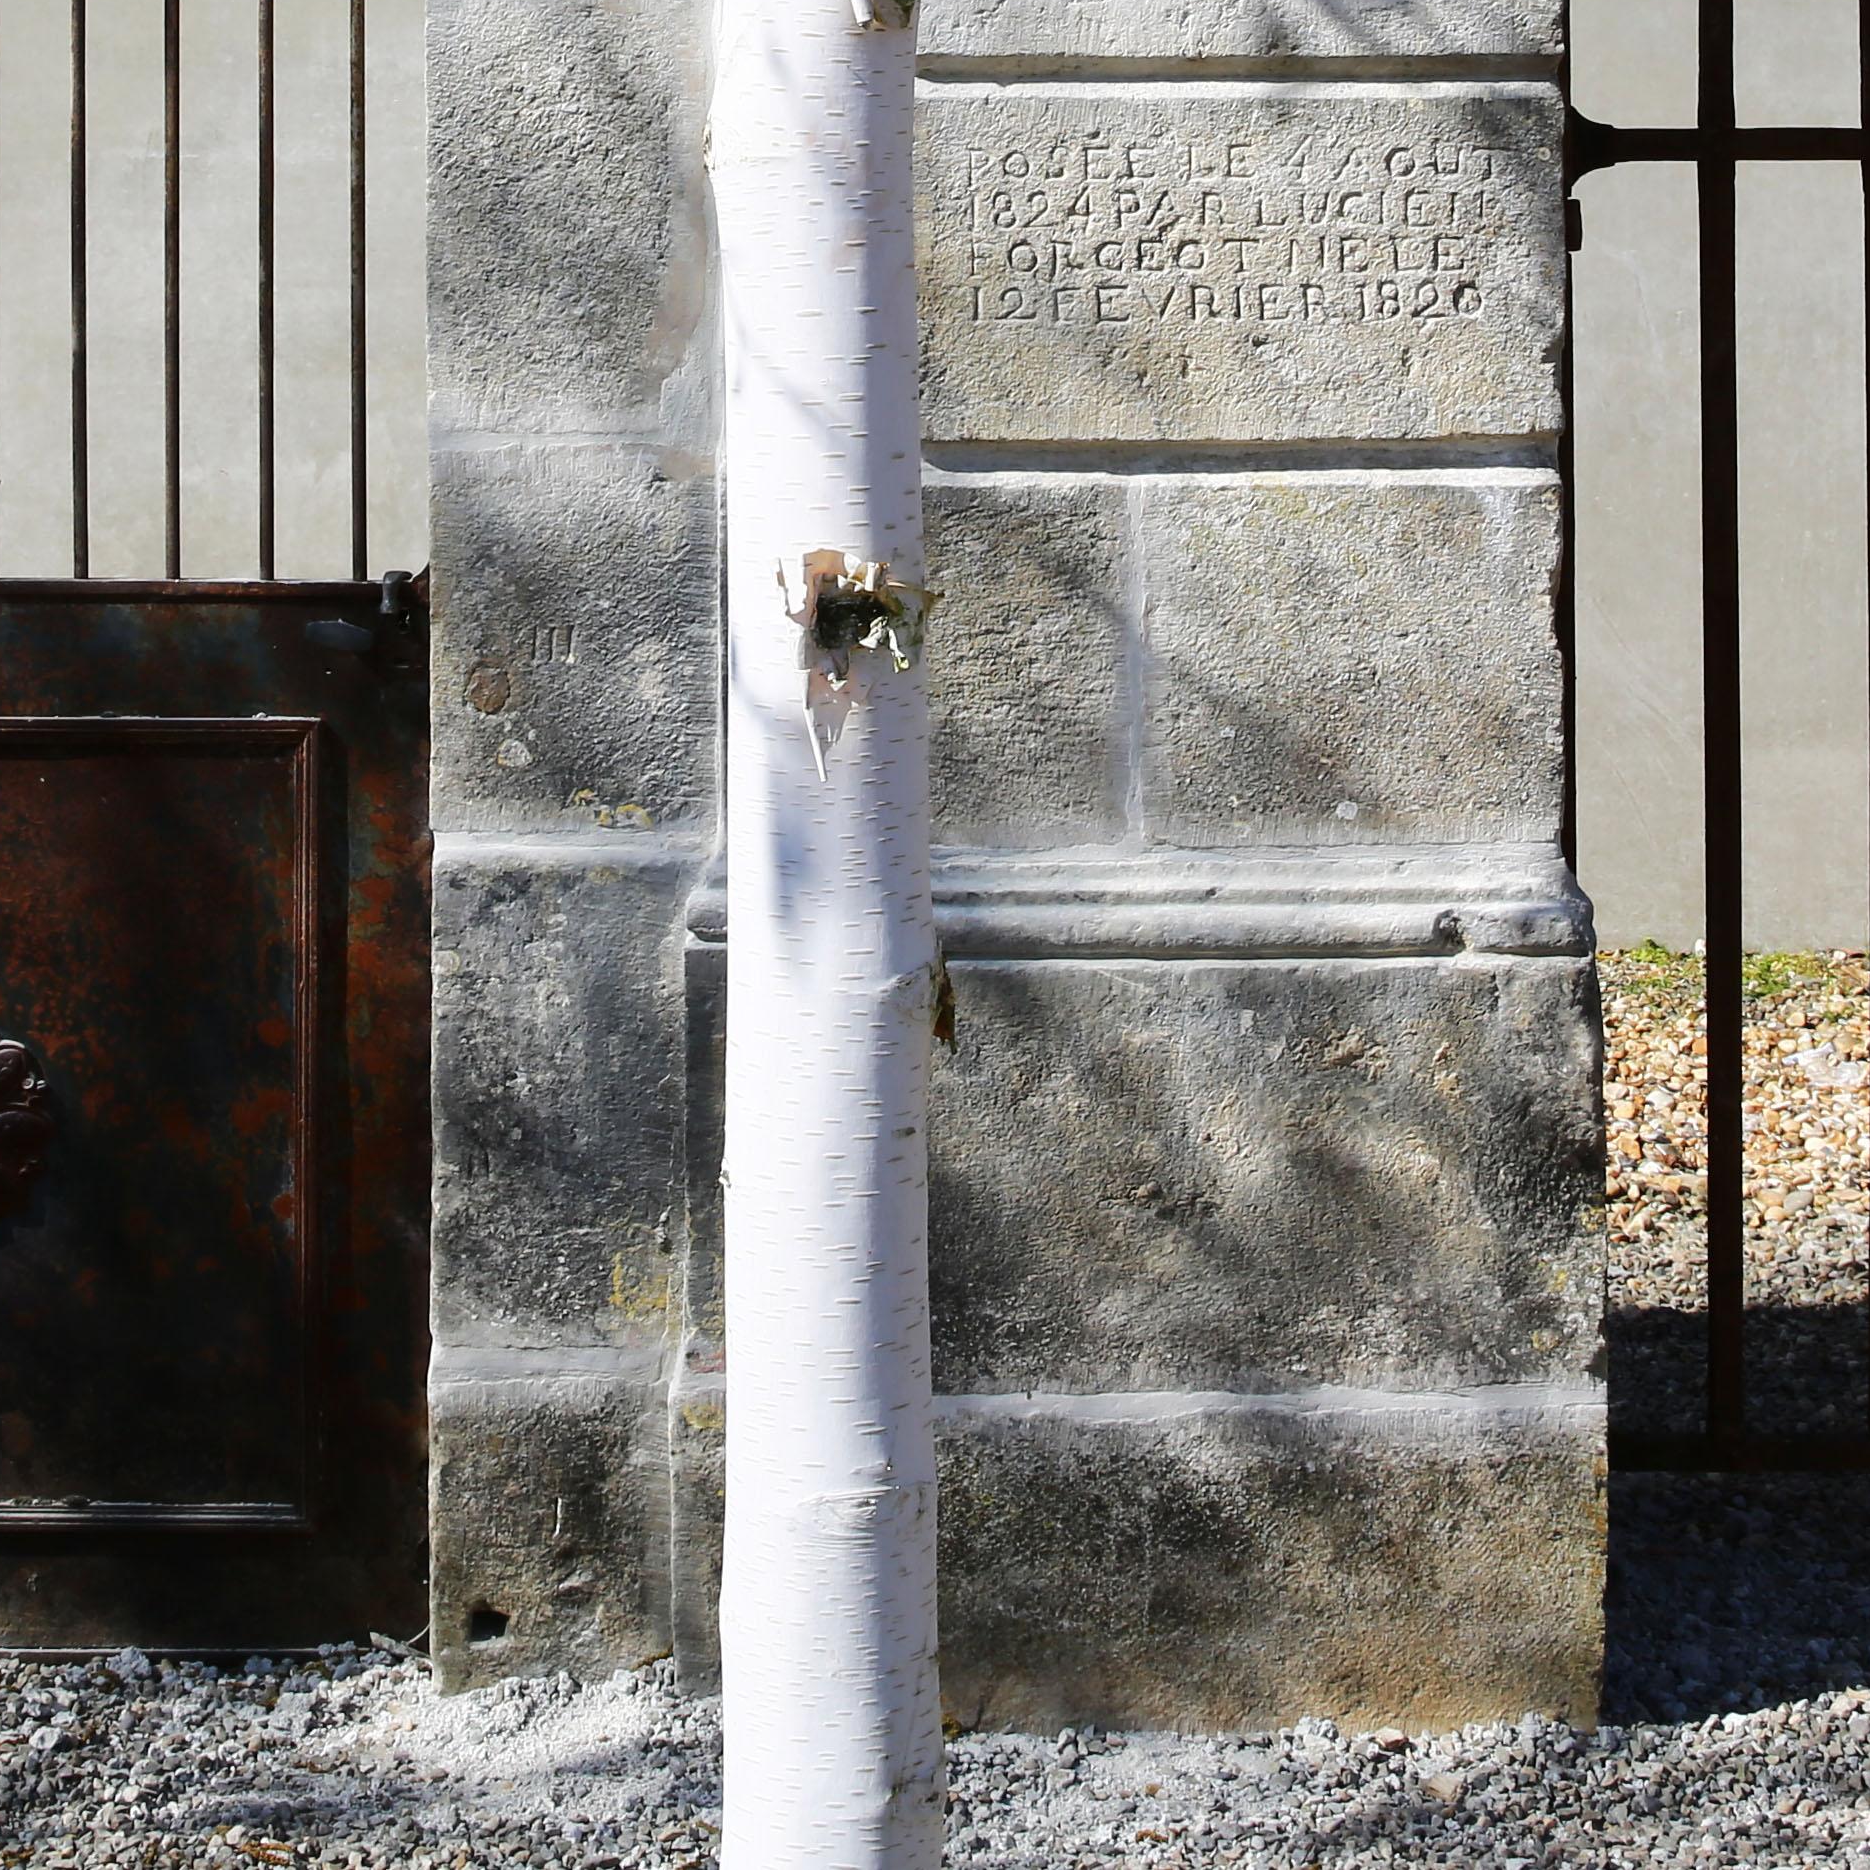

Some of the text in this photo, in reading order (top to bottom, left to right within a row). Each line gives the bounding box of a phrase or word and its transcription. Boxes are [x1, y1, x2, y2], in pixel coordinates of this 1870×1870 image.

[1185, 143, 1254, 180] LE
[1280, 133, 1315, 180] 4
[968, 186, 1486, 232] 1824 PAR LUCIEN
[1389, 235, 1466, 271] LE
[968, 285, 1037, 321] 12
